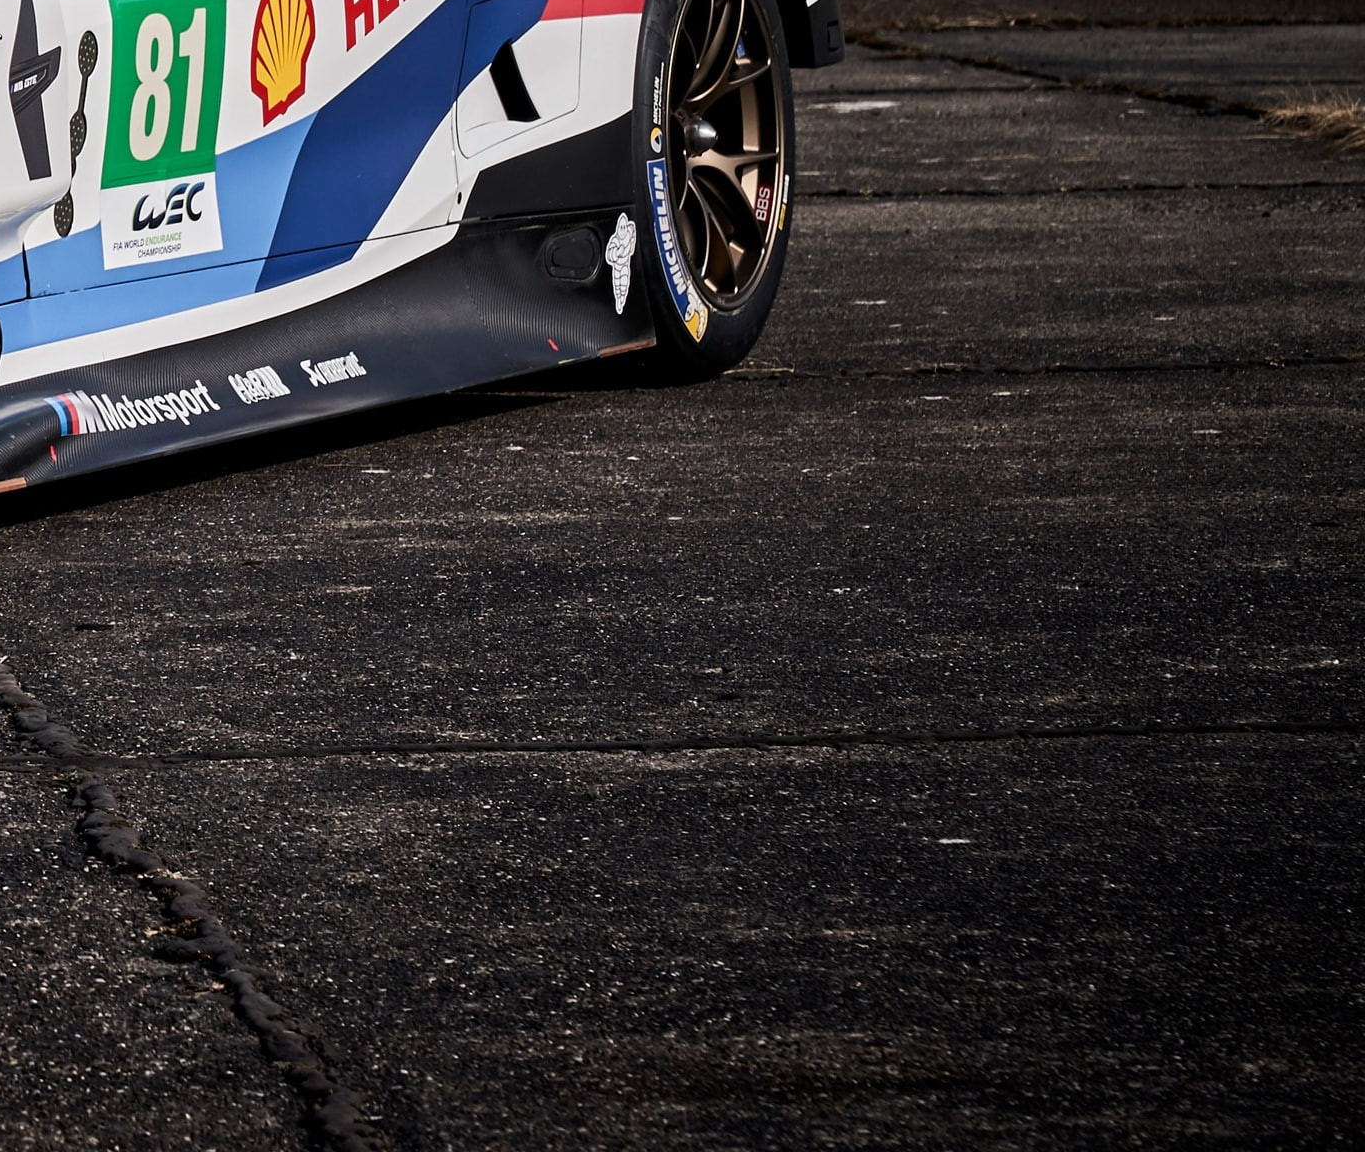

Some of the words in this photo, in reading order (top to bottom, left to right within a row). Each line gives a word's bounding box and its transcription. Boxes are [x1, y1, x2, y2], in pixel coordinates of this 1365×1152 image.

[129, 7, 206, 161] 81
[132, 182, 206, 232] WEC
[755, 187, 770, 222] BBS
[113, 242, 123, 251] FIA
[124, 238, 145, 249] WORLD
[145, 232, 182, 246] ENDURANCE
[138, 243, 182, 259] CHAMPIONSHIP
[653, 166, 687, 296] MICHELIN
[91, 380, 221, 432] Motorsport
